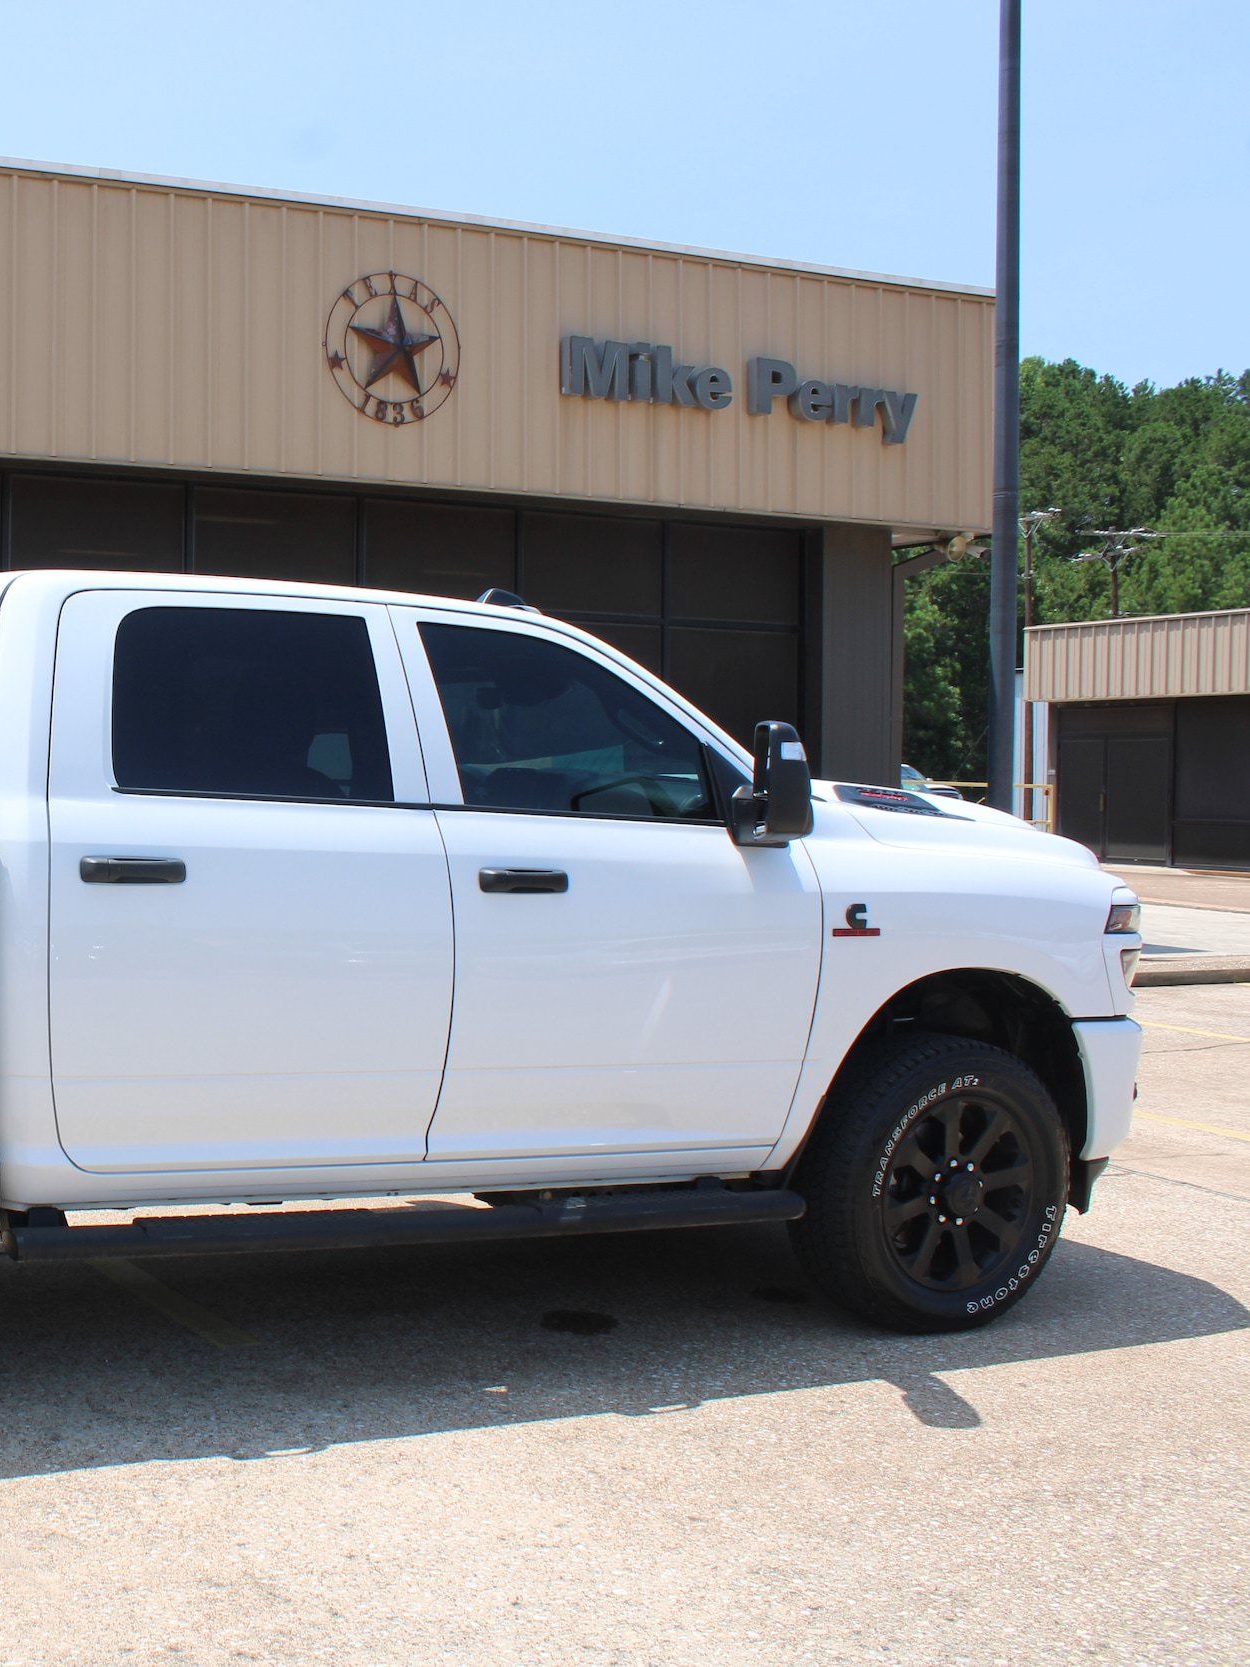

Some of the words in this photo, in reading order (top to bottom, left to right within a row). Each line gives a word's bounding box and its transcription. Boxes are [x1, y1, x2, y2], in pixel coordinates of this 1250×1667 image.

[342, 271, 442, 316] TEXAS
[356, 393, 425, 428] 1836
[560, 335, 733, 411] Mike
[748, 356, 918, 446] Perry
[872, 1083, 947, 1198] TRANSFORCE
